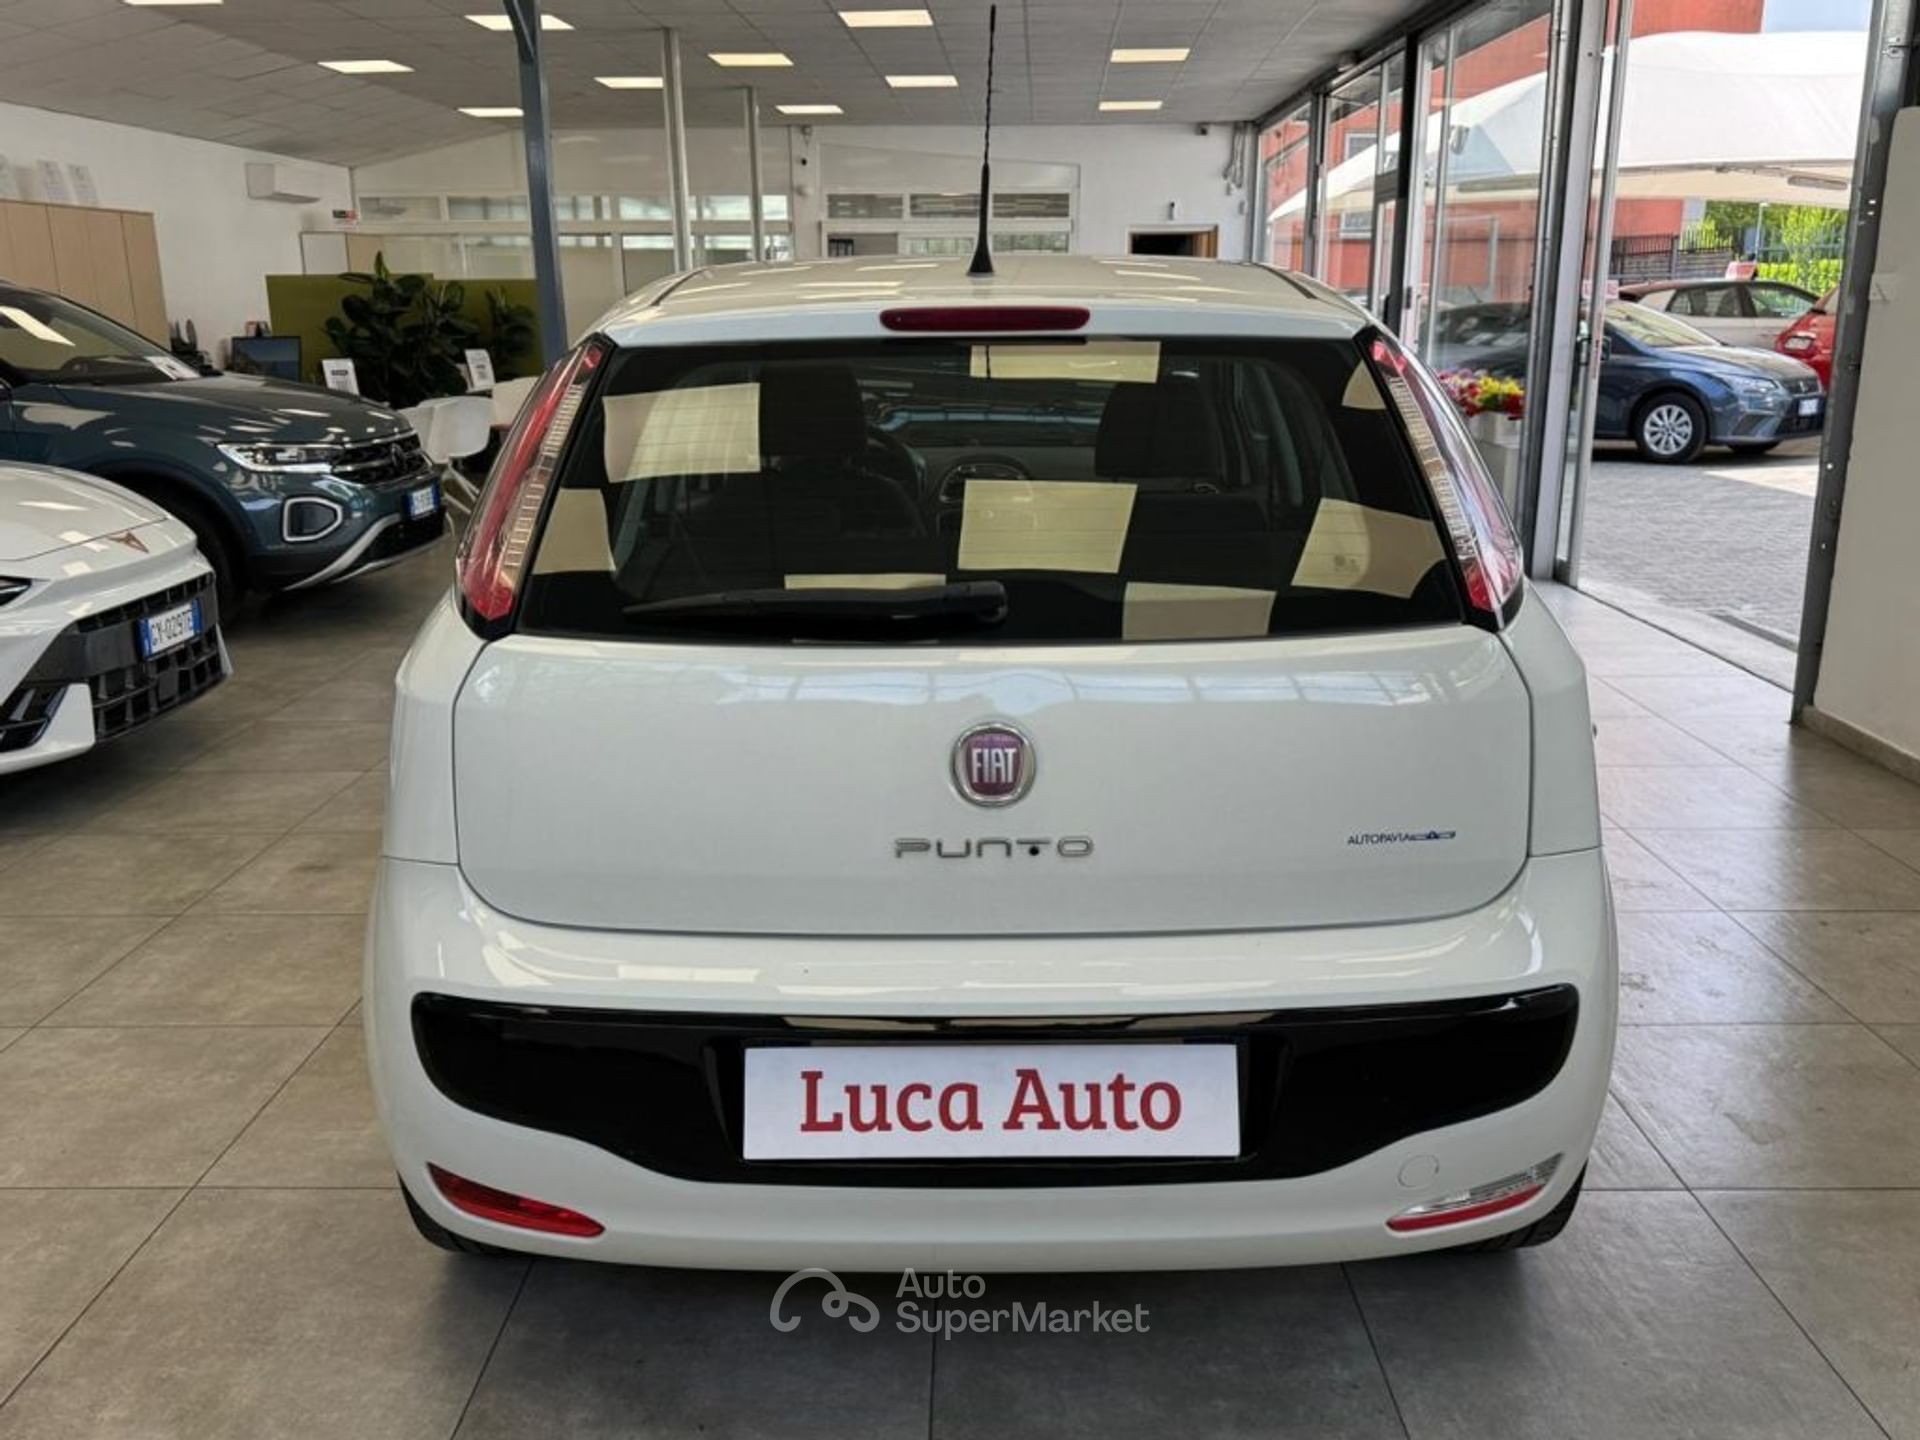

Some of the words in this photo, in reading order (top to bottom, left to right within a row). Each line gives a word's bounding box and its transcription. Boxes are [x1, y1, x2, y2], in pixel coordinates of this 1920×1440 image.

[972, 748, 1017, 784] FIAT
[895, 836, 1094, 858] PUNTO
[800, 1071, 983, 1131] Luca
[1002, 1069, 1182, 1131] Auto
